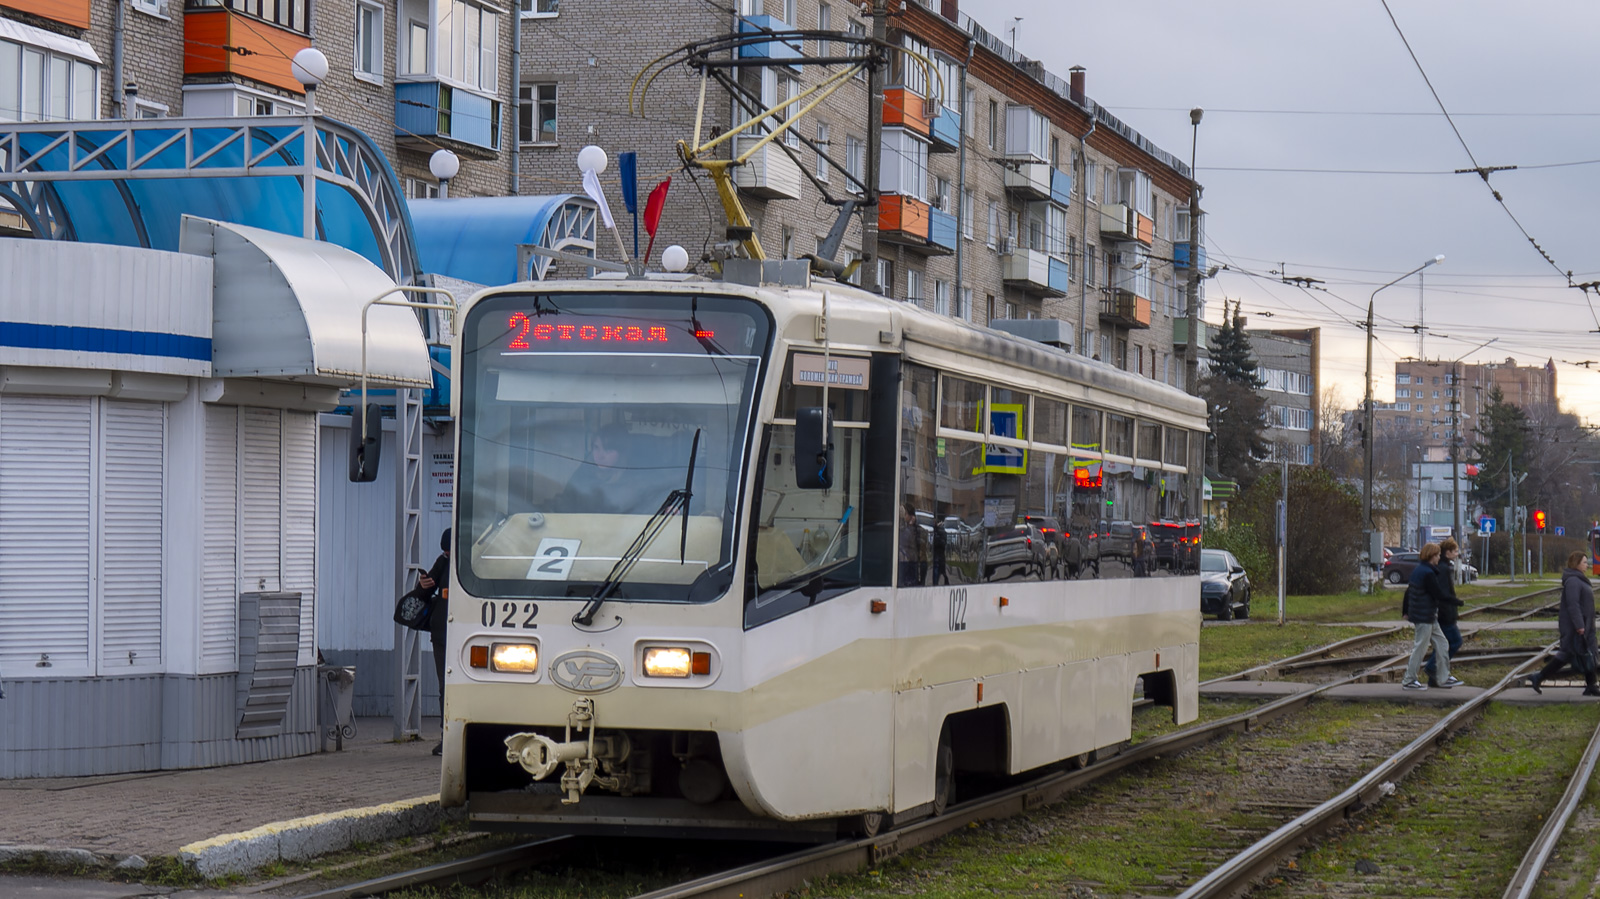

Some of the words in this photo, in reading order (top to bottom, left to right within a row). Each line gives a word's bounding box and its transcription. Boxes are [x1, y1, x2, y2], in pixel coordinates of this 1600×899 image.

[800, 370, 838, 383] КОЛОМЕНКИЙ
[839, 373, 863, 385] ТРАМВАЙ
[536, 545, 569, 574] 2
[481, 601, 539, 629] 022
[949, 588, 968, 632] 022
